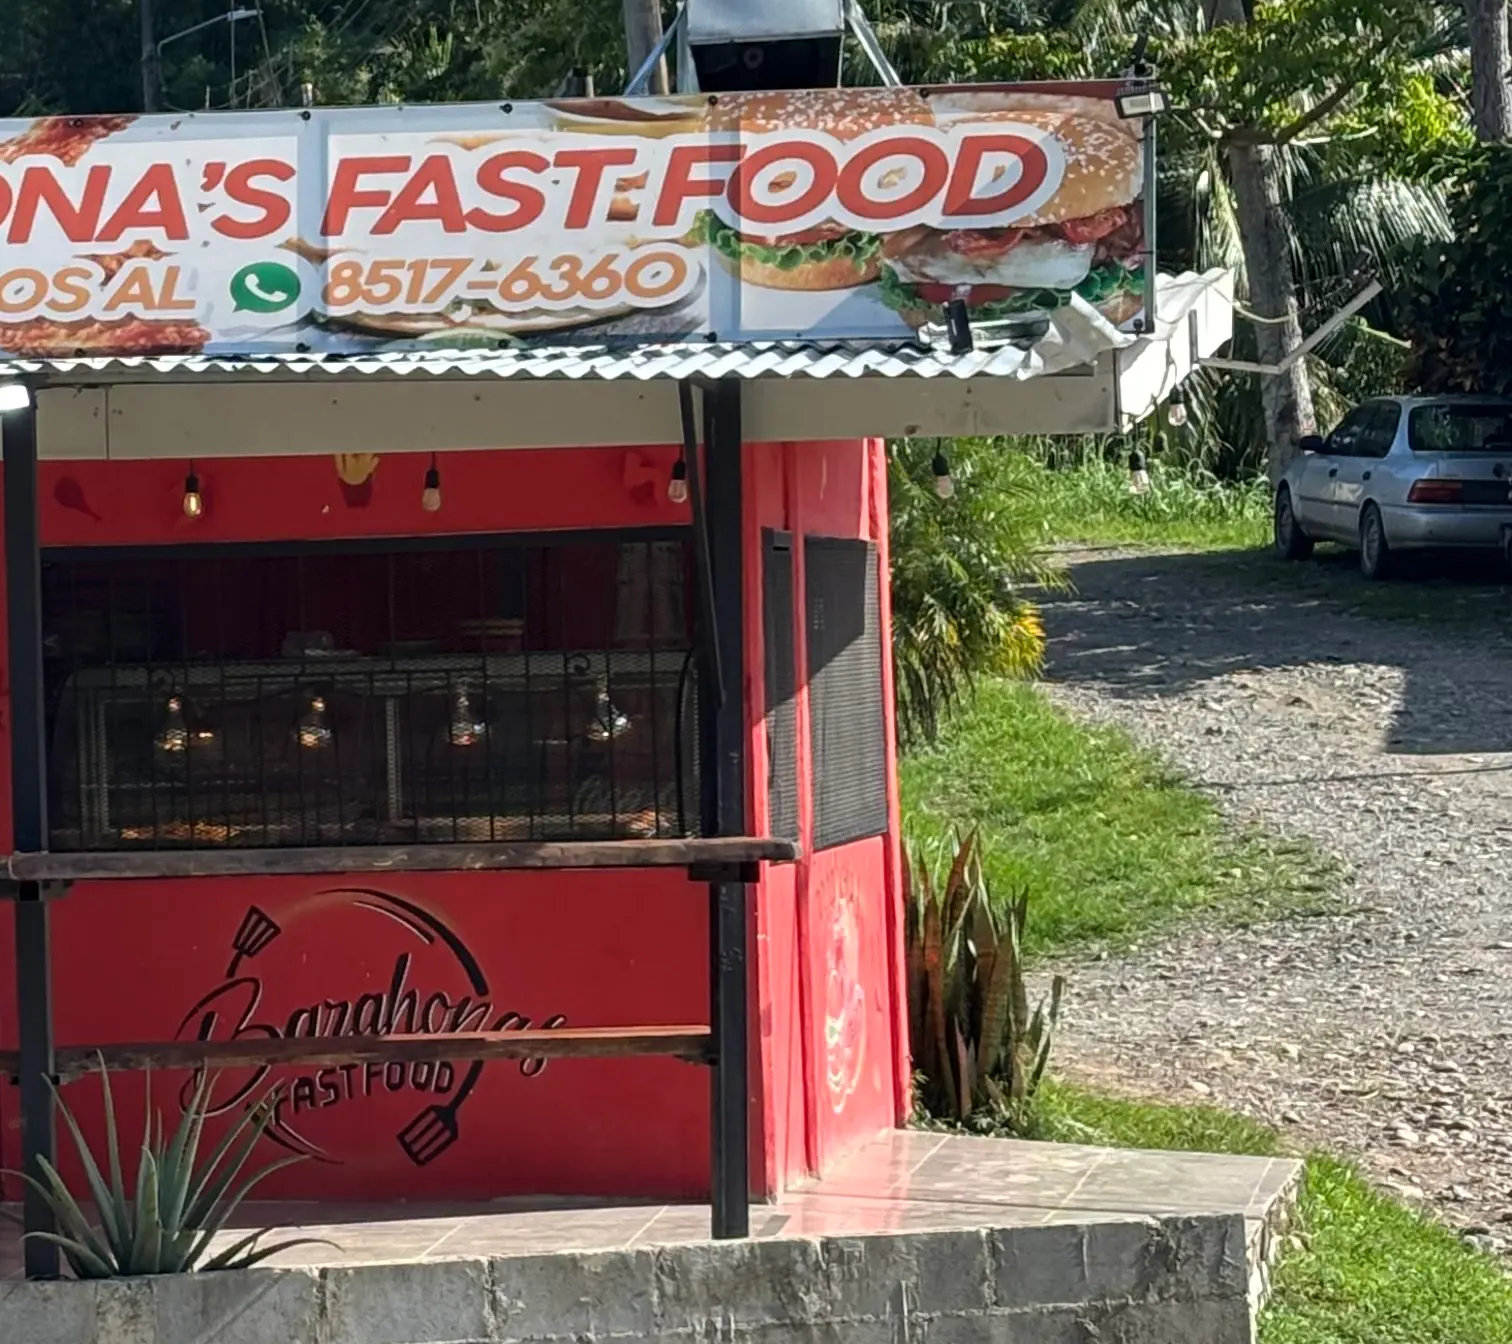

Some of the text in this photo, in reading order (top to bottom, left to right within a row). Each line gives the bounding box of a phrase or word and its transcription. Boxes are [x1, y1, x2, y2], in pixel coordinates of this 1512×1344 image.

[320, 148, 637, 237] FAST
[652, 134, 1048, 227] FOOD
[102, 265, 196, 311] AL
[328, 250, 687, 308] 8517-6360
[362, 1059, 455, 1096] FOOD
